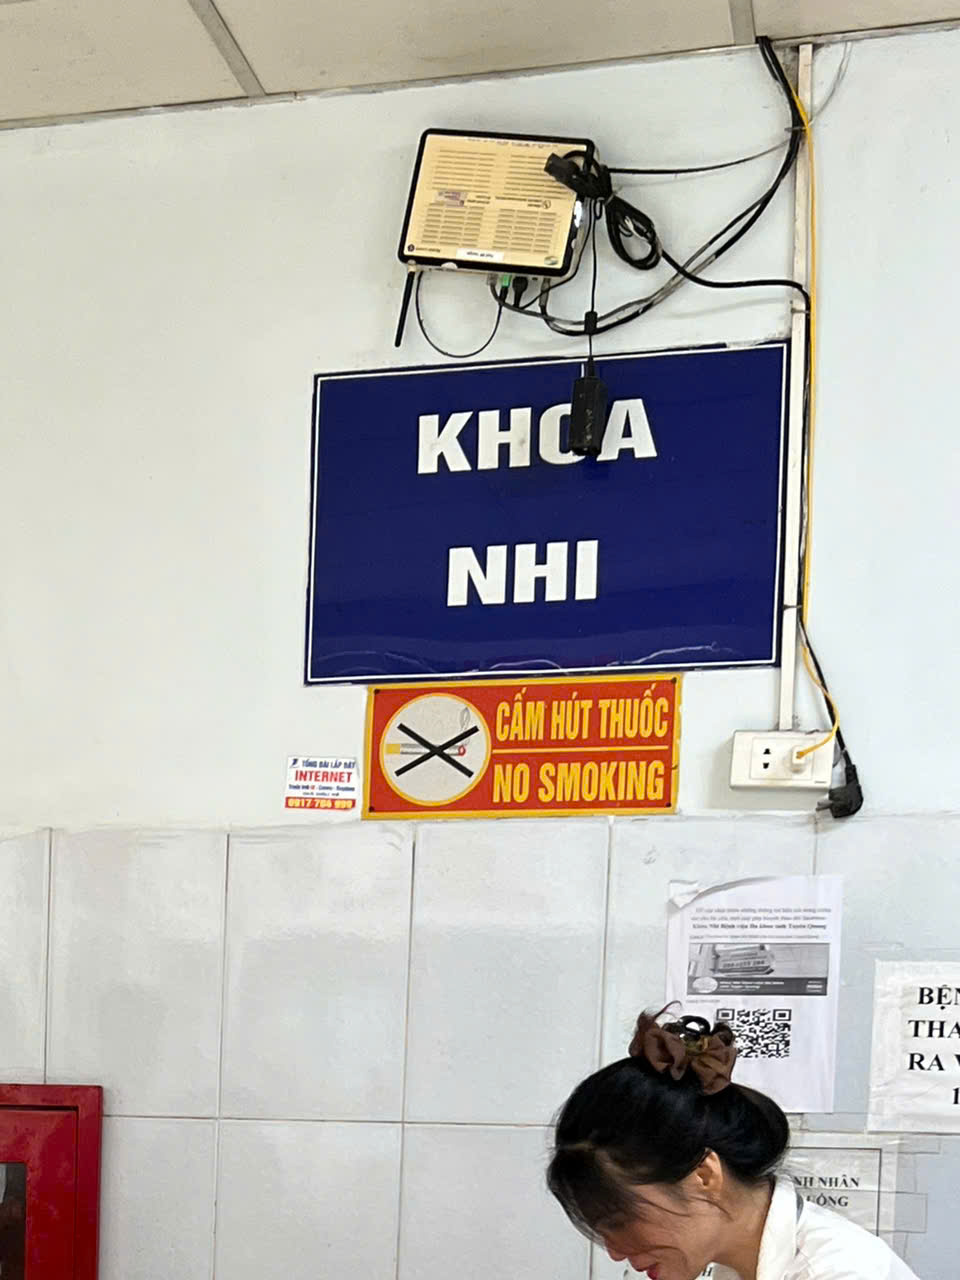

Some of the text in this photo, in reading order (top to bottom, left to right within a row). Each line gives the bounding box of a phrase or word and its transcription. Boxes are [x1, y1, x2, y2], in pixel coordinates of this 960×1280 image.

[417, 398, 658, 475] KHOA
[447, 540, 599, 607] NHI
[496, 684, 669, 742] CẤM HÚT THUỐC
[295, 770, 353, 783] INTERNET
[493, 760, 665, 803] NO SMOKING
[908, 1053, 945, 1071] RA
[818, 1174, 860, 1188] NHÂN
